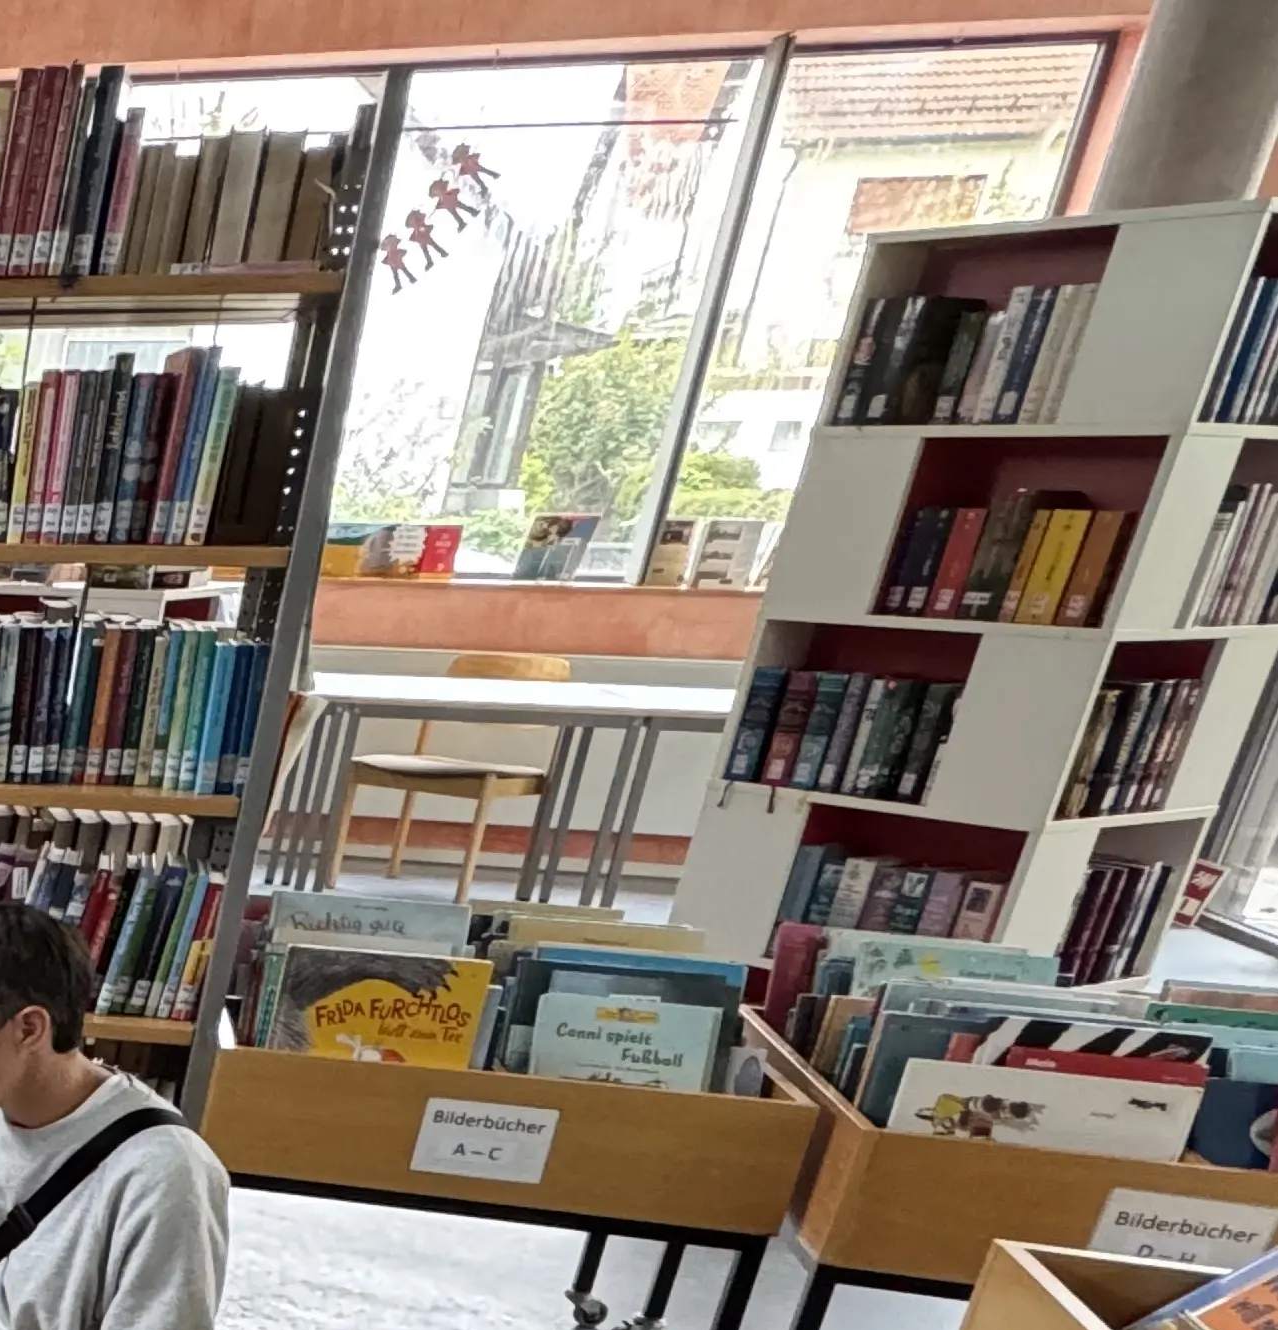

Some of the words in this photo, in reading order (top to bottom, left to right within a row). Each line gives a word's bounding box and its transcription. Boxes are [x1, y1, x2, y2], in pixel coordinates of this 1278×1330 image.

[315, 999, 366, 1028] FRIDA
[370, 996, 472, 1028] FURCHTLOS
[556, 1022, 601, 1041] Conni
[606, 1029, 653, 1047] spielt
[620, 1048, 684, 1068] Fußball
[432, 1109, 547, 1135] Bilderbücher
[450, 1142, 466, 1156] A
[488, 1147, 503, 1161] C
[1114, 1210, 1260, 1245] Bilderbücher
[1135, 1243, 1155, 1259] D
